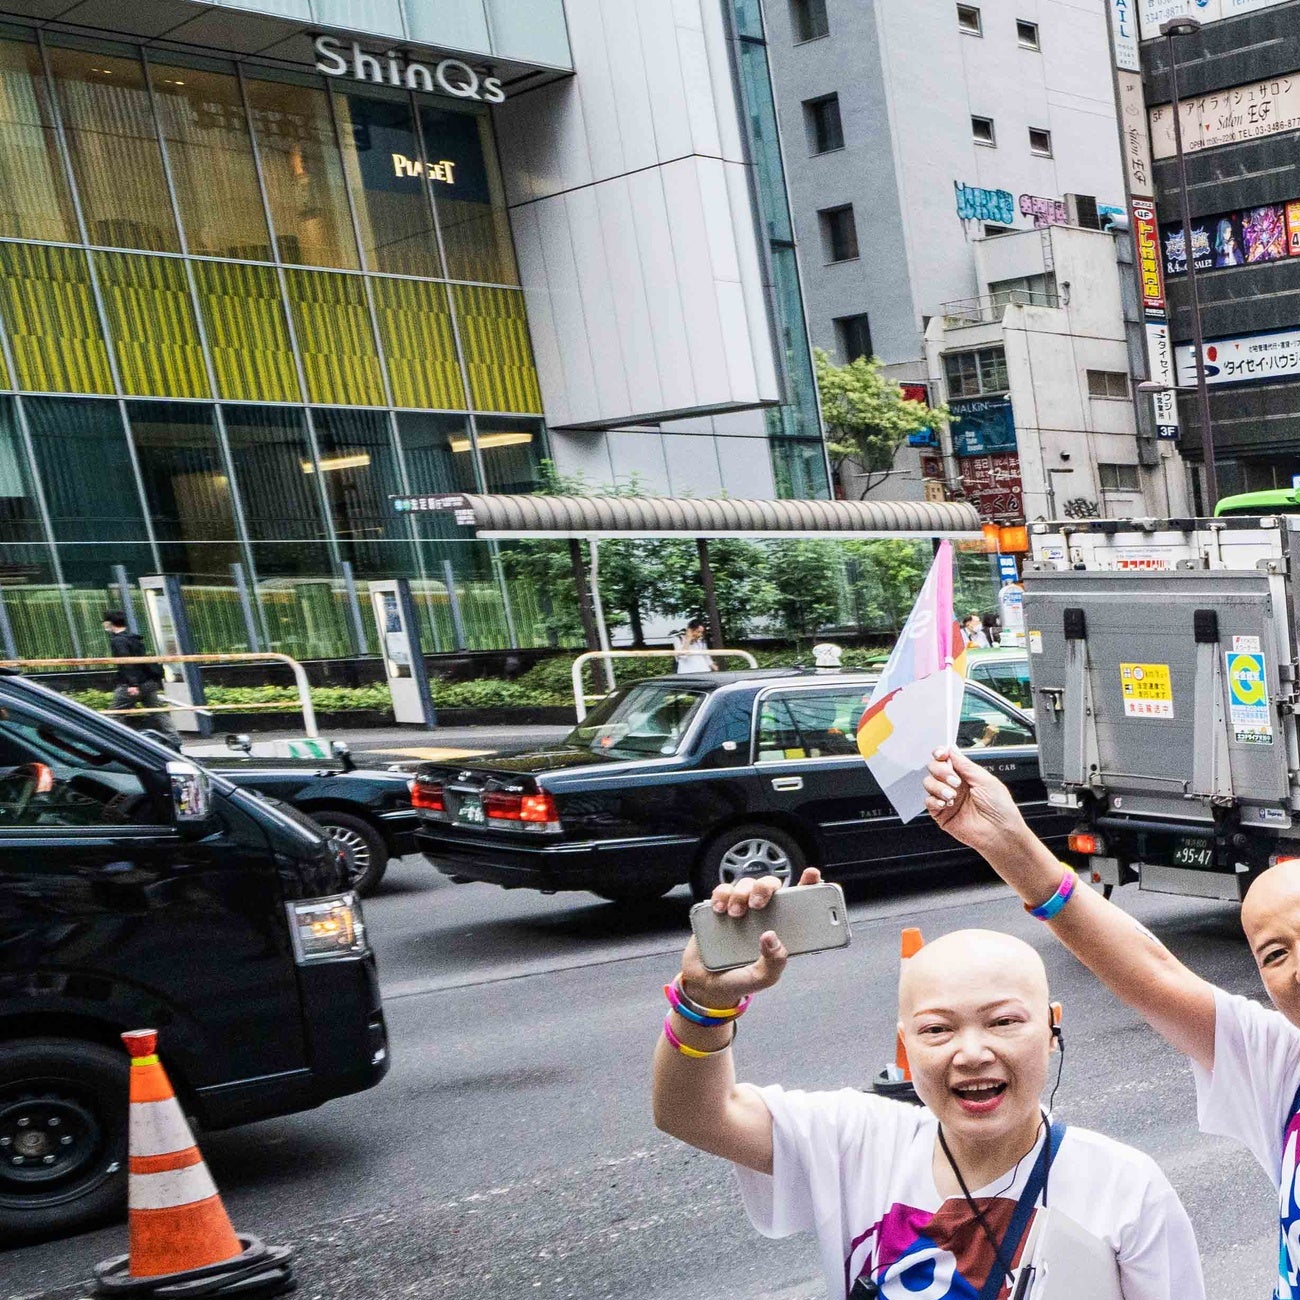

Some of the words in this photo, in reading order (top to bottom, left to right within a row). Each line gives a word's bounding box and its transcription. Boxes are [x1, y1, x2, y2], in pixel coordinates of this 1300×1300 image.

[314, 35, 505, 103] ShinQs
[392, 153, 455, 184] PIAGET
[1160, 427, 1175, 436] 3F
[999, 764, 1016, 772] CAB
[1182, 847, 1213, 865] 95-47
